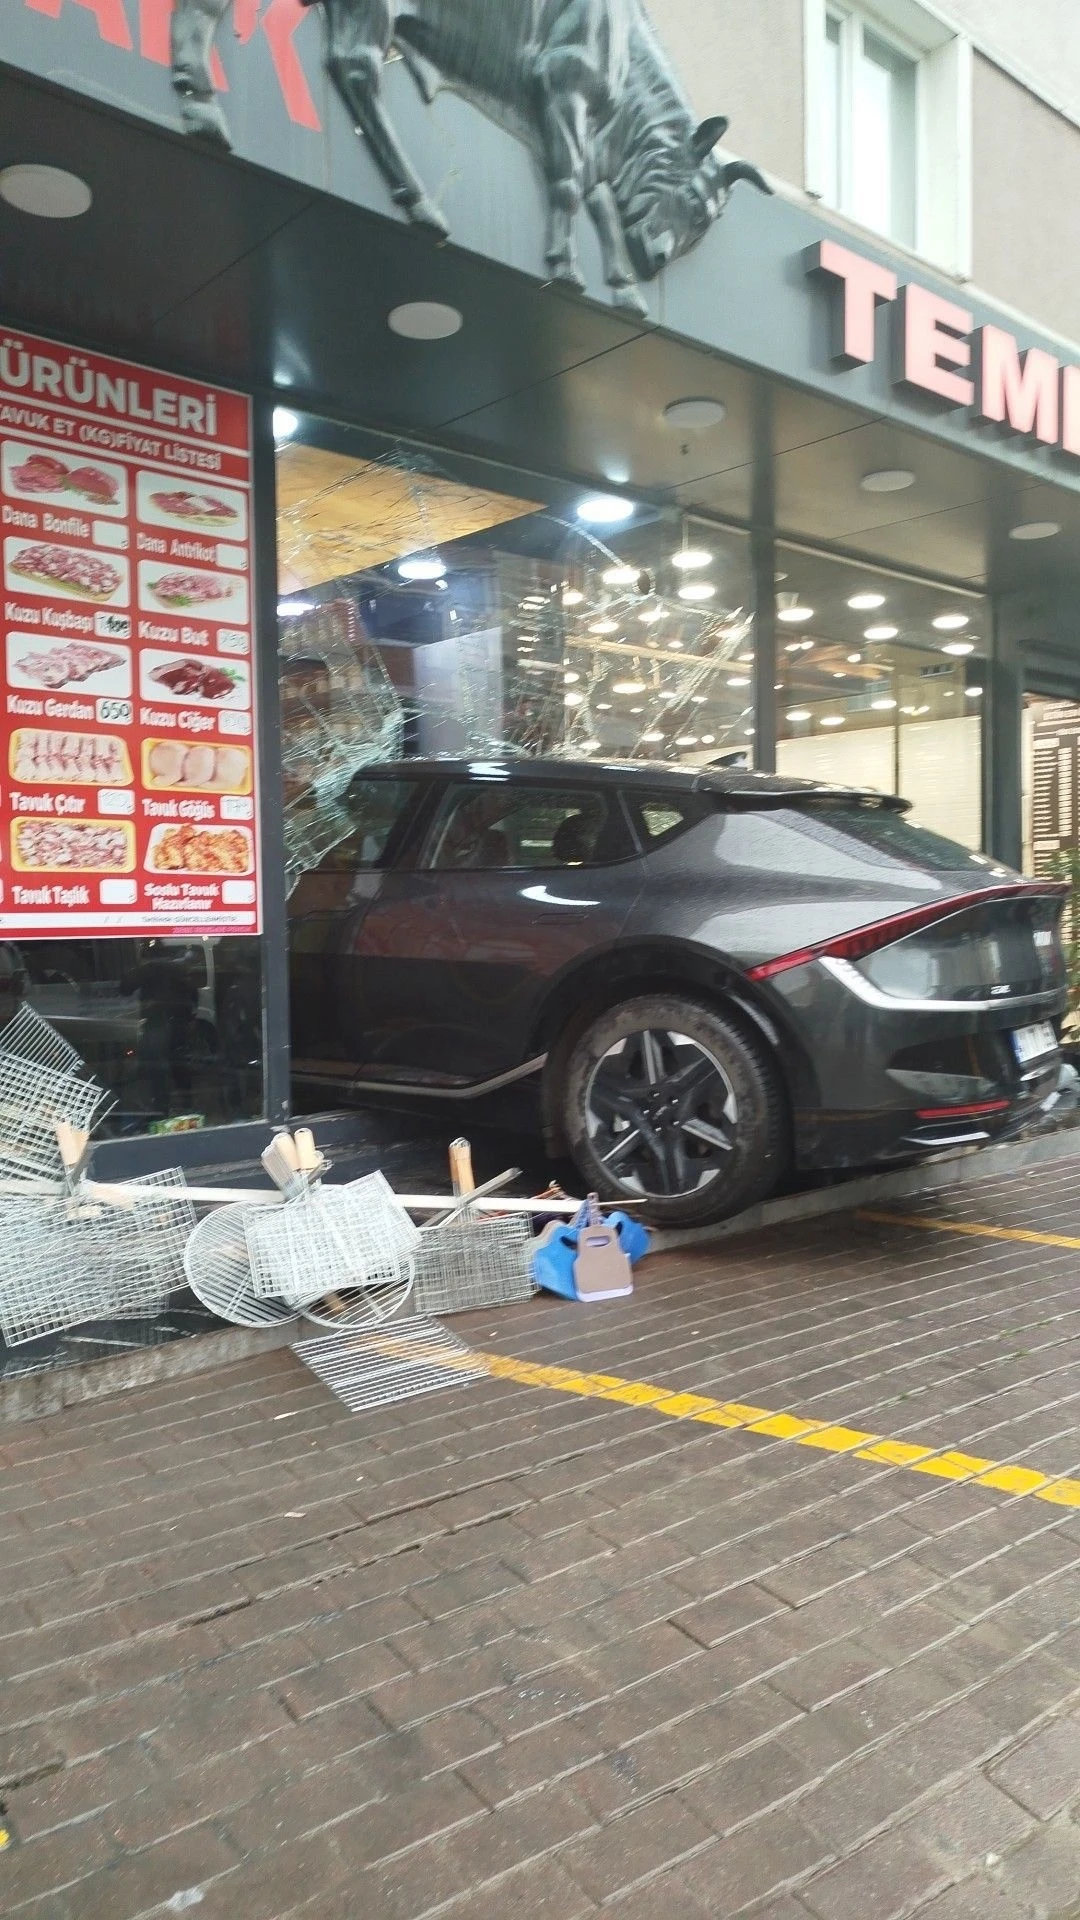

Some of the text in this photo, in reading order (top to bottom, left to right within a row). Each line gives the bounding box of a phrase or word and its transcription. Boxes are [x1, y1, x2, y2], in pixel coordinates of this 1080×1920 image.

[0, 339, 218, 436] ÜRÜNLERİ
[0, 404, 50, 431] AVUK
[53, 418, 76, 436] ET
[2, 505, 38, 528] Dana
[136, 532, 167, 554] Dana
[5, 602, 41, 624] Kuzu
[138, 621, 179, 643] Kuzu
[181, 627, 209, 647] But
[7, 694, 95, 721] Kuzu Gerdan
[101, 700, 130, 720] 650
[139, 707, 177, 727] Kuzu
[178, 710, 216, 733] Ciğer
[9, 792, 54, 812] Tavuk
[142, 798, 178, 817] Tavuk
[11, 885, 52, 904] Tavuk
[180, 883, 220, 897] Tavuk
